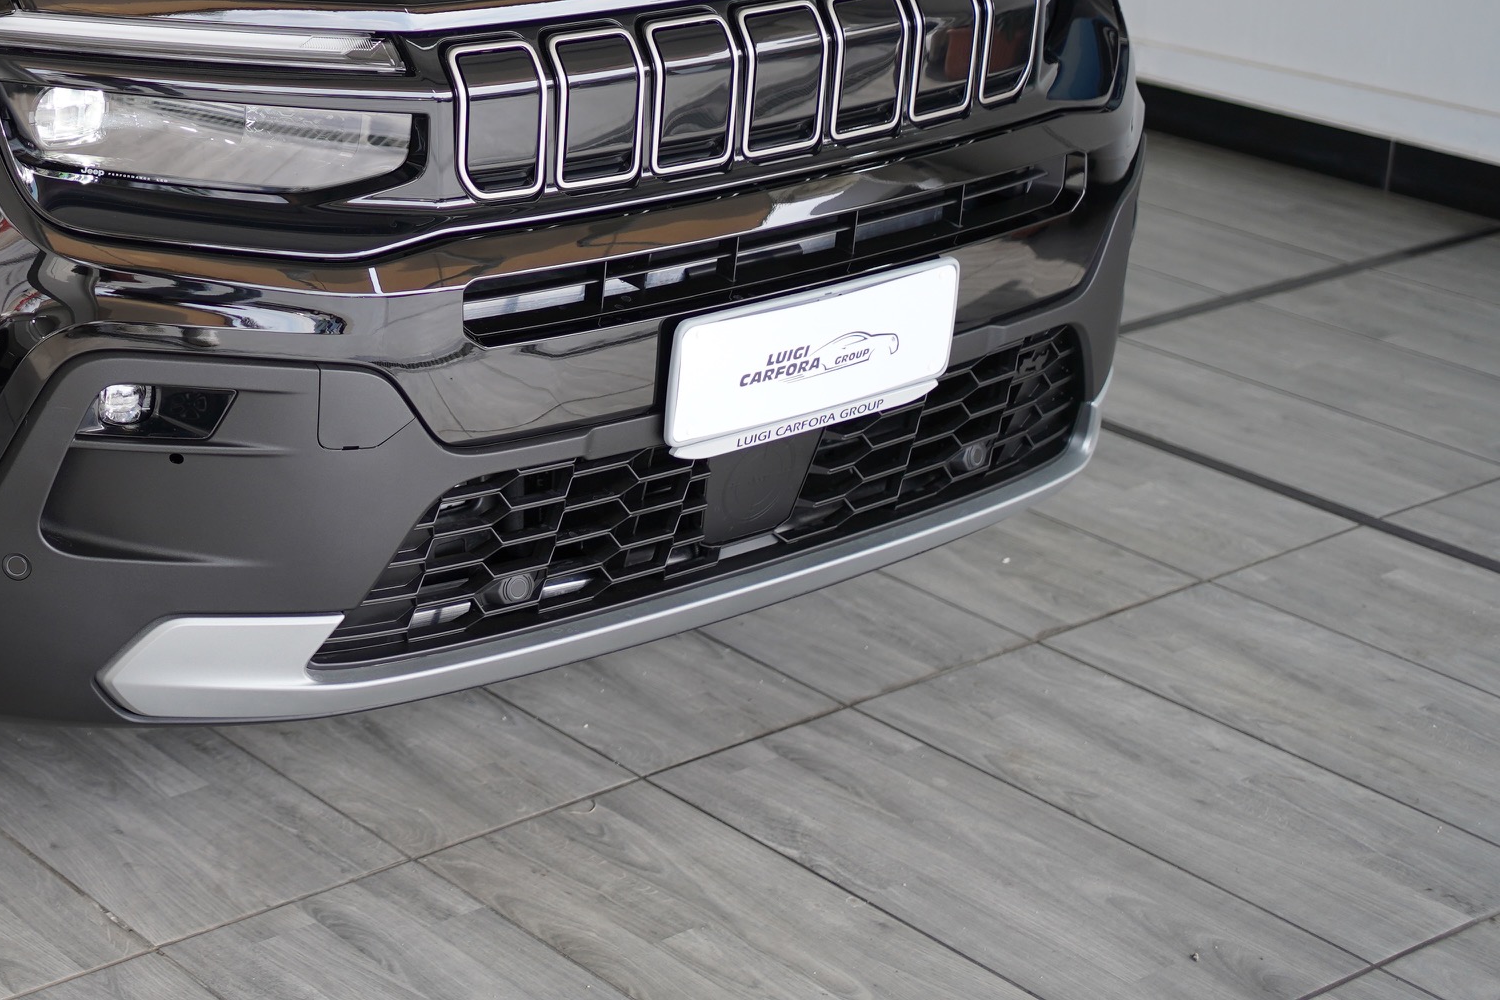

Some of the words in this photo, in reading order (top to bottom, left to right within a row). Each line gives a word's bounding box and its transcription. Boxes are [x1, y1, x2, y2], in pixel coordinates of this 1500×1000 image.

[80, 166, 105, 177] Jeep
[739, 357, 821, 388] CARFORA
[834, 348, 870, 366] GROUP
[766, 345, 811, 367] LUIGI
[736, 430, 772, 448] LUIGI
[775, 412, 836, 437] CARFORA
[839, 399, 884, 419] GROUP
